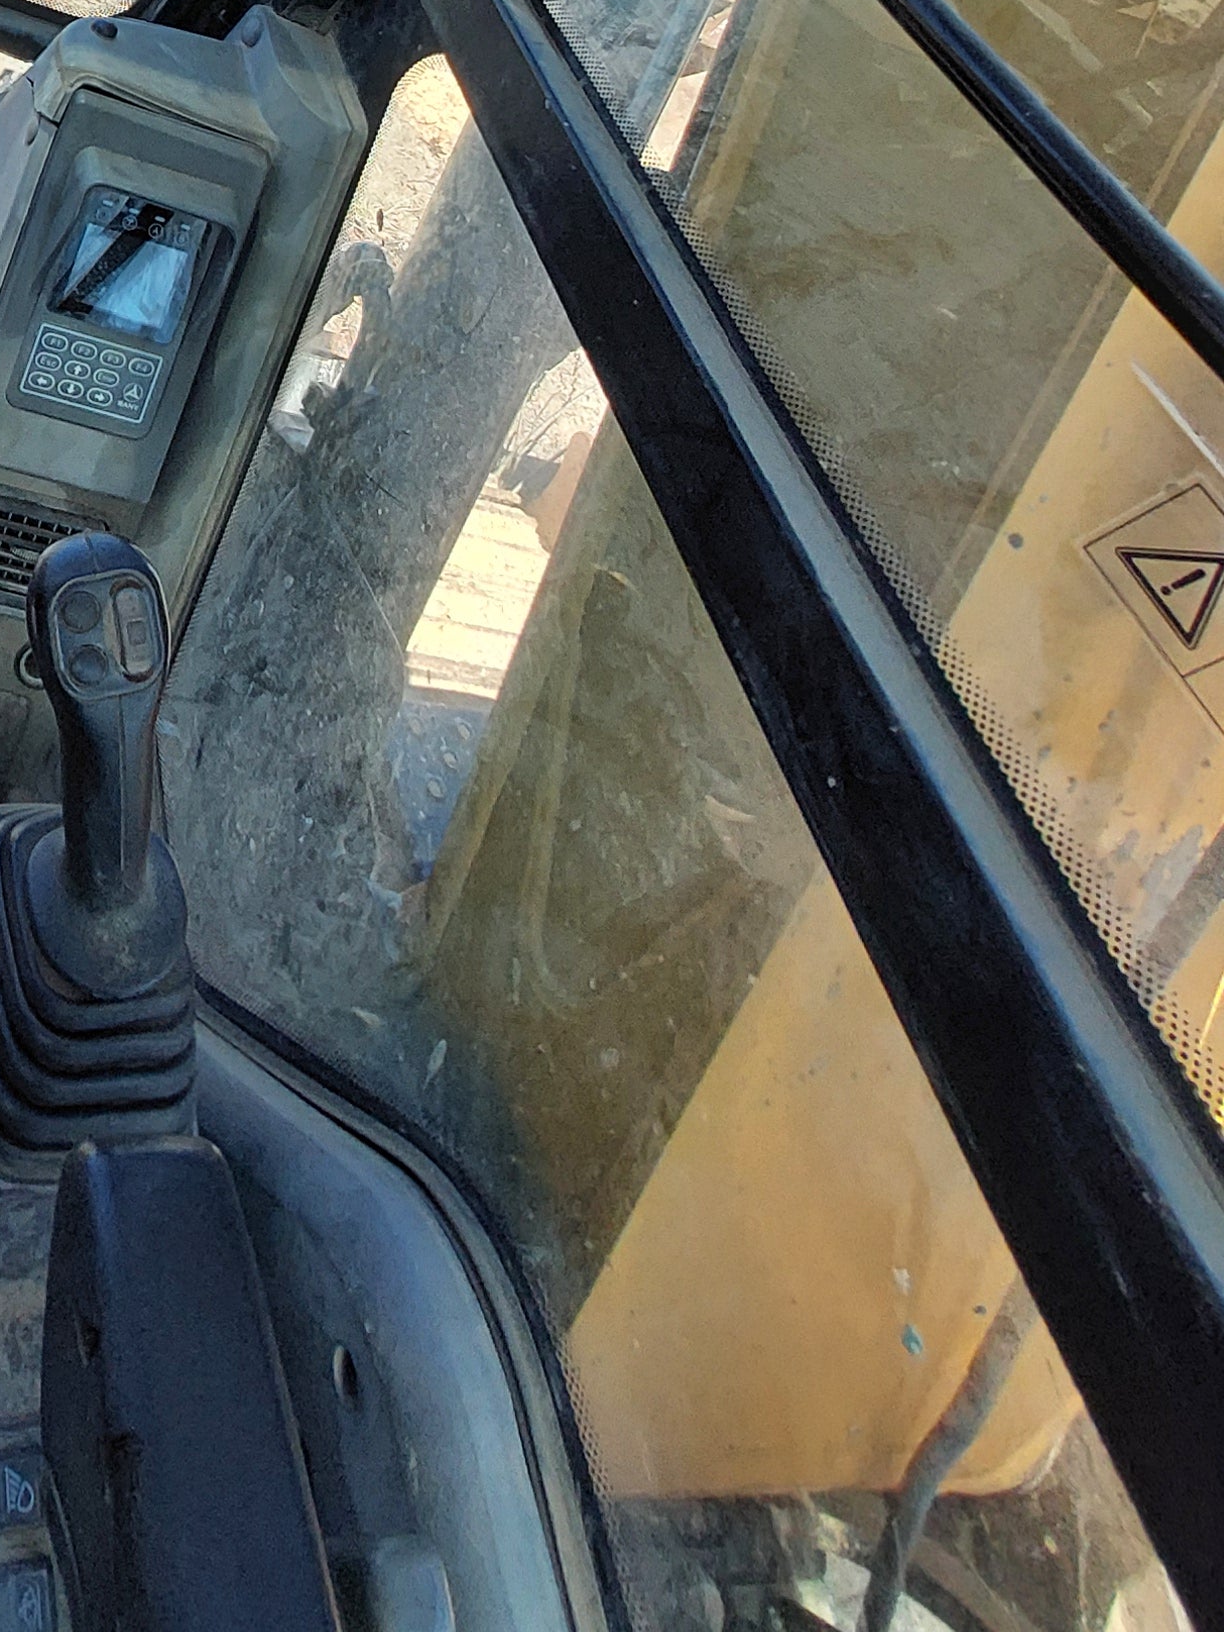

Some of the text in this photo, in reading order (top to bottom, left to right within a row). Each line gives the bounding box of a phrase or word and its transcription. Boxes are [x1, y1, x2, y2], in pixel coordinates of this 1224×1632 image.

[49, 337, 62, 346] F1
[78, 346, 91, 356] F2
[107, 354, 119, 365] F3
[39, 356, 56, 368] Esc
